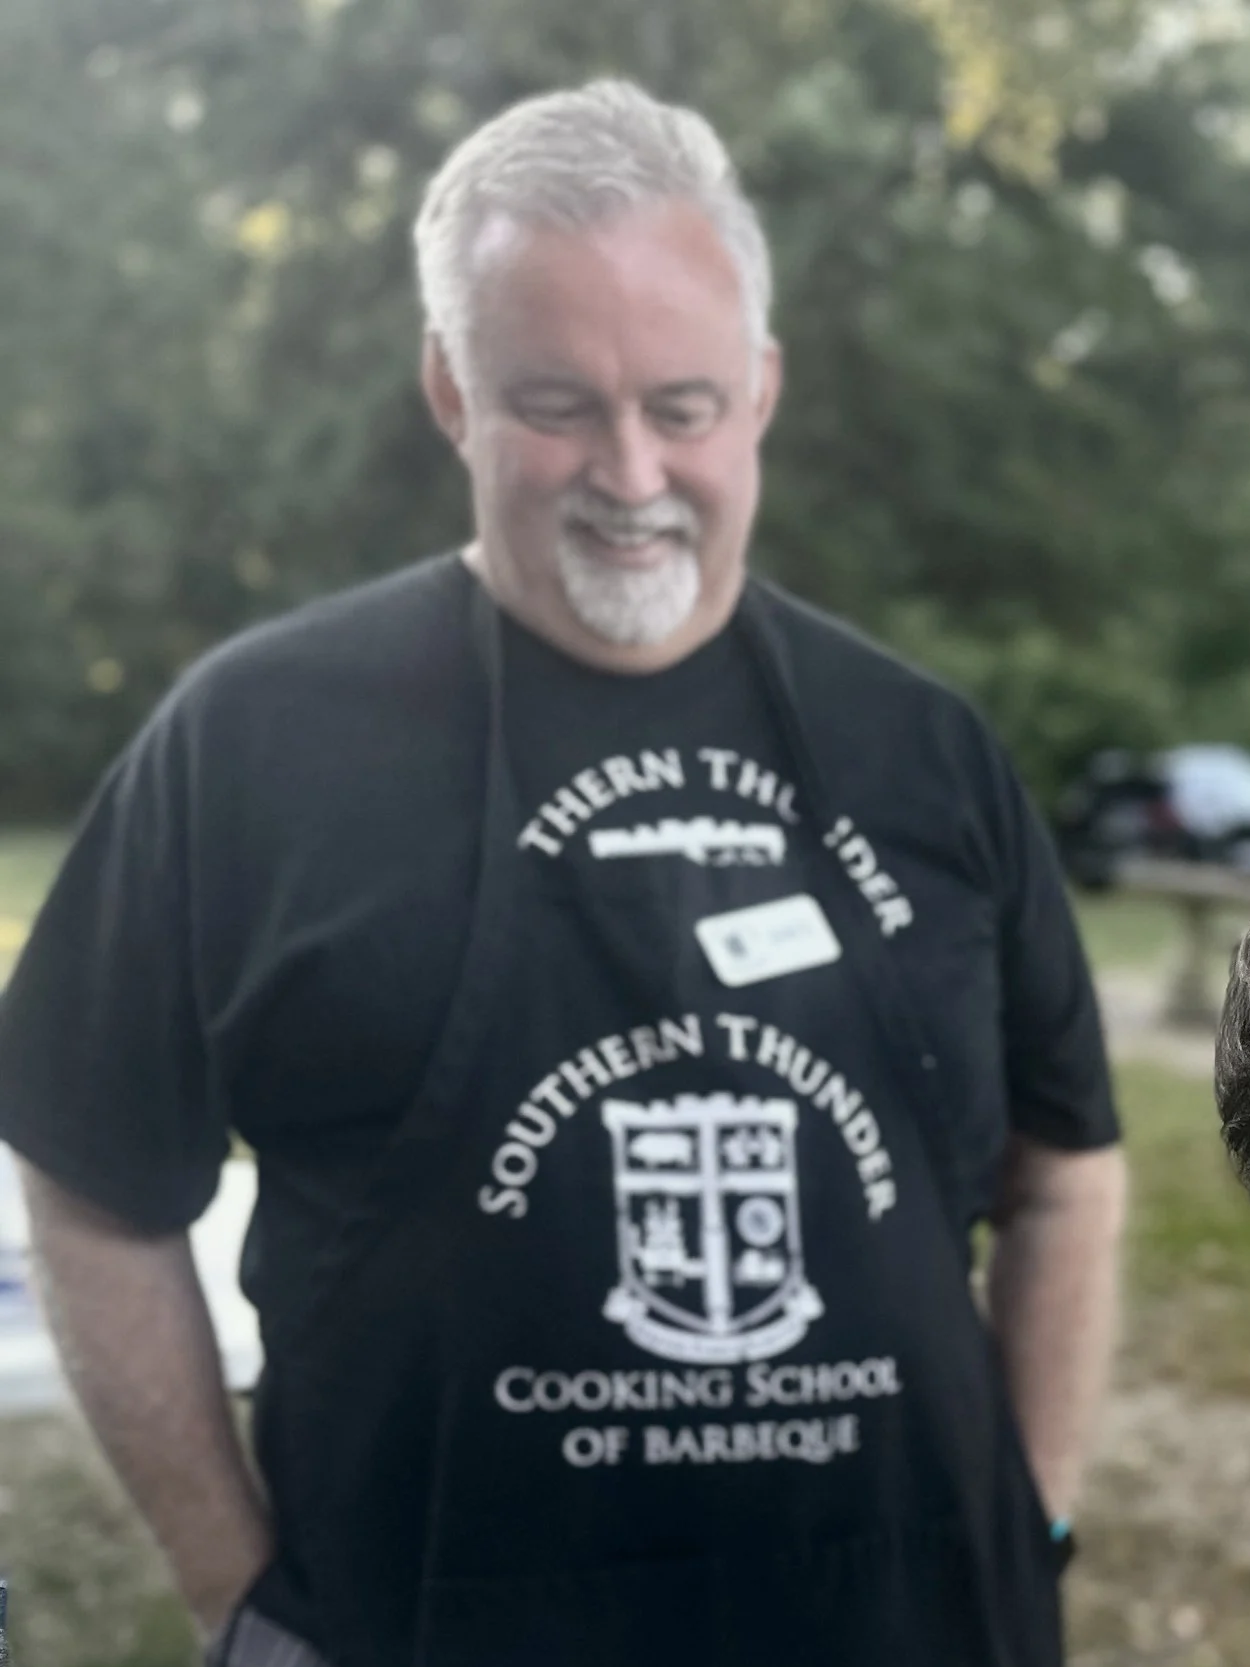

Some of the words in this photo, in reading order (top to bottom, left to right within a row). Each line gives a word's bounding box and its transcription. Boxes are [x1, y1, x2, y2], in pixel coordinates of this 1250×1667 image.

[517, 748, 686, 857] THERN
[478, 1013, 704, 1219] SOUTHERN
[715, 1012, 897, 1222] THUNDER
[562, 1426, 630, 1468] OF
[643, 1414, 862, 1464] BARBEQUE
